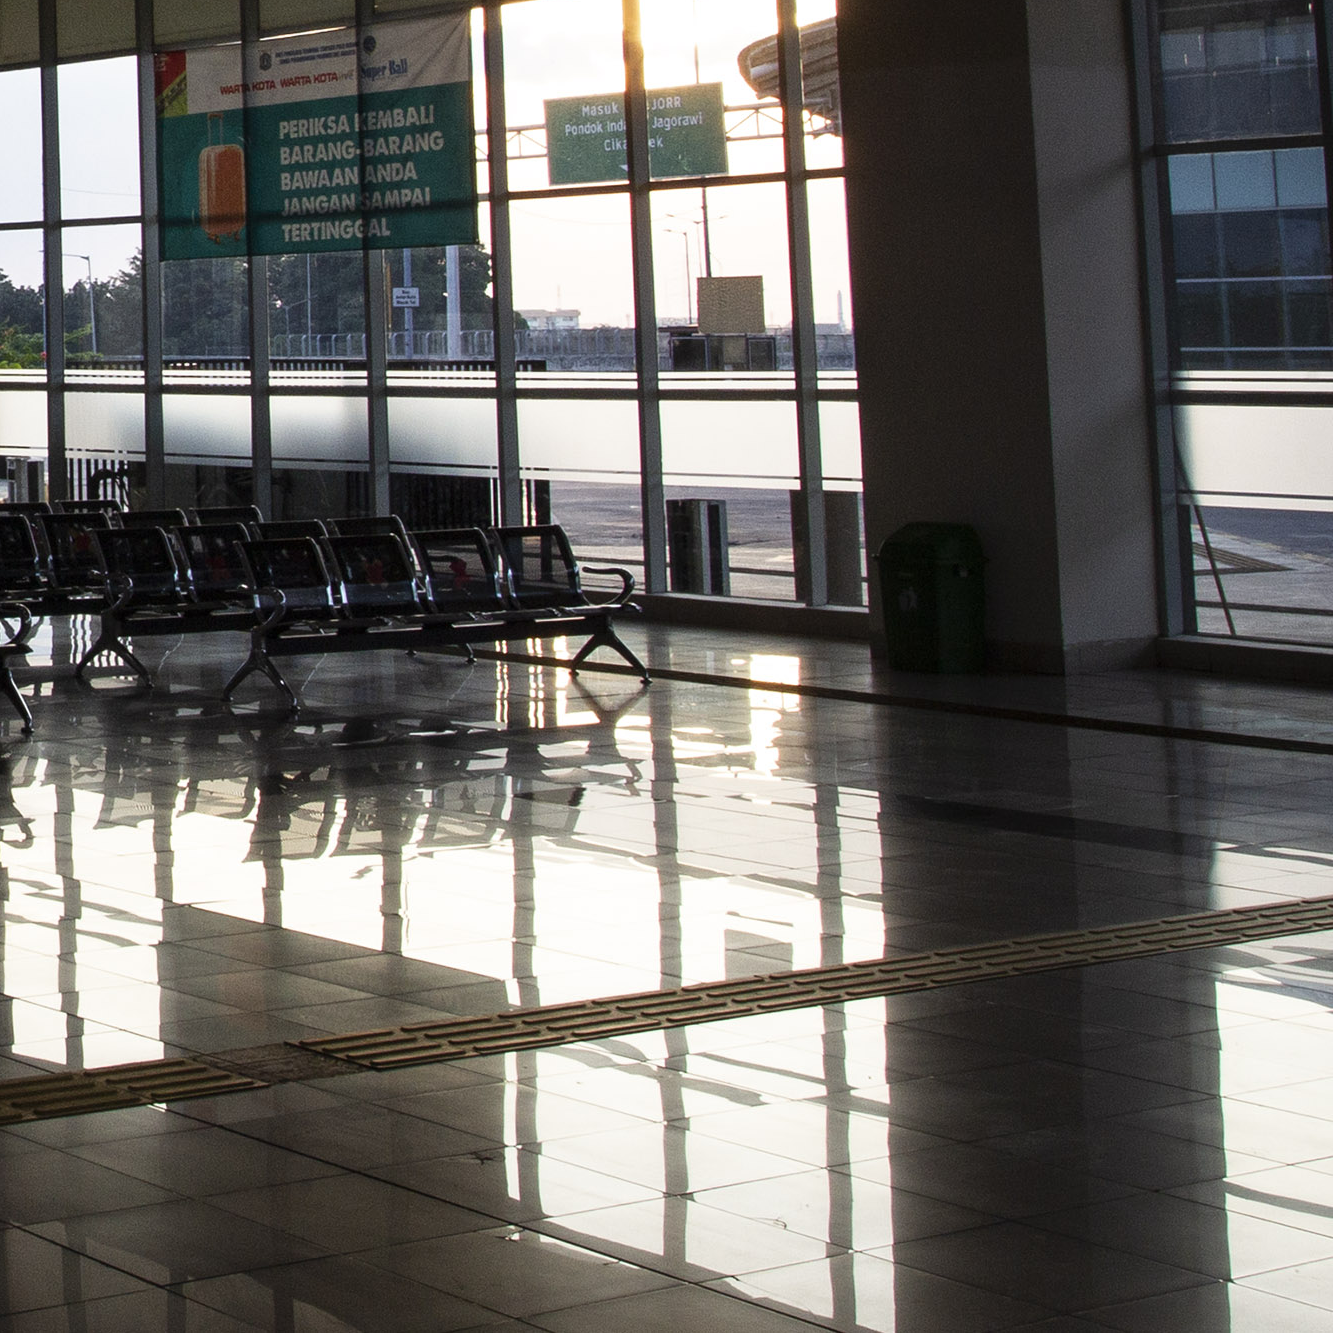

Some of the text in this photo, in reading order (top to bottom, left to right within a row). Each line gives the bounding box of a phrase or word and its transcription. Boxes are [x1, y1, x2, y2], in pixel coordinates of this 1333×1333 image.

[220, 80, 276, 96] WARTA KOTA
[280, 76, 311, 89] WARTA
[314, 72, 339, 85] KOTA
[582, 96, 682, 117] Masuk JORR
[279, 104, 434, 140] PERIKSA KEMBALI
[565, 123, 604, 136] Pondok
[652, 112, 703, 131] Jagorawi
[279, 130, 445, 165] BARANG-BARANG
[280, 161, 418, 191] BAWAAN ANDA
[281, 187, 431, 217] JANGAN SAMPAI
[282, 218, 391, 243] TERTINGGAL
